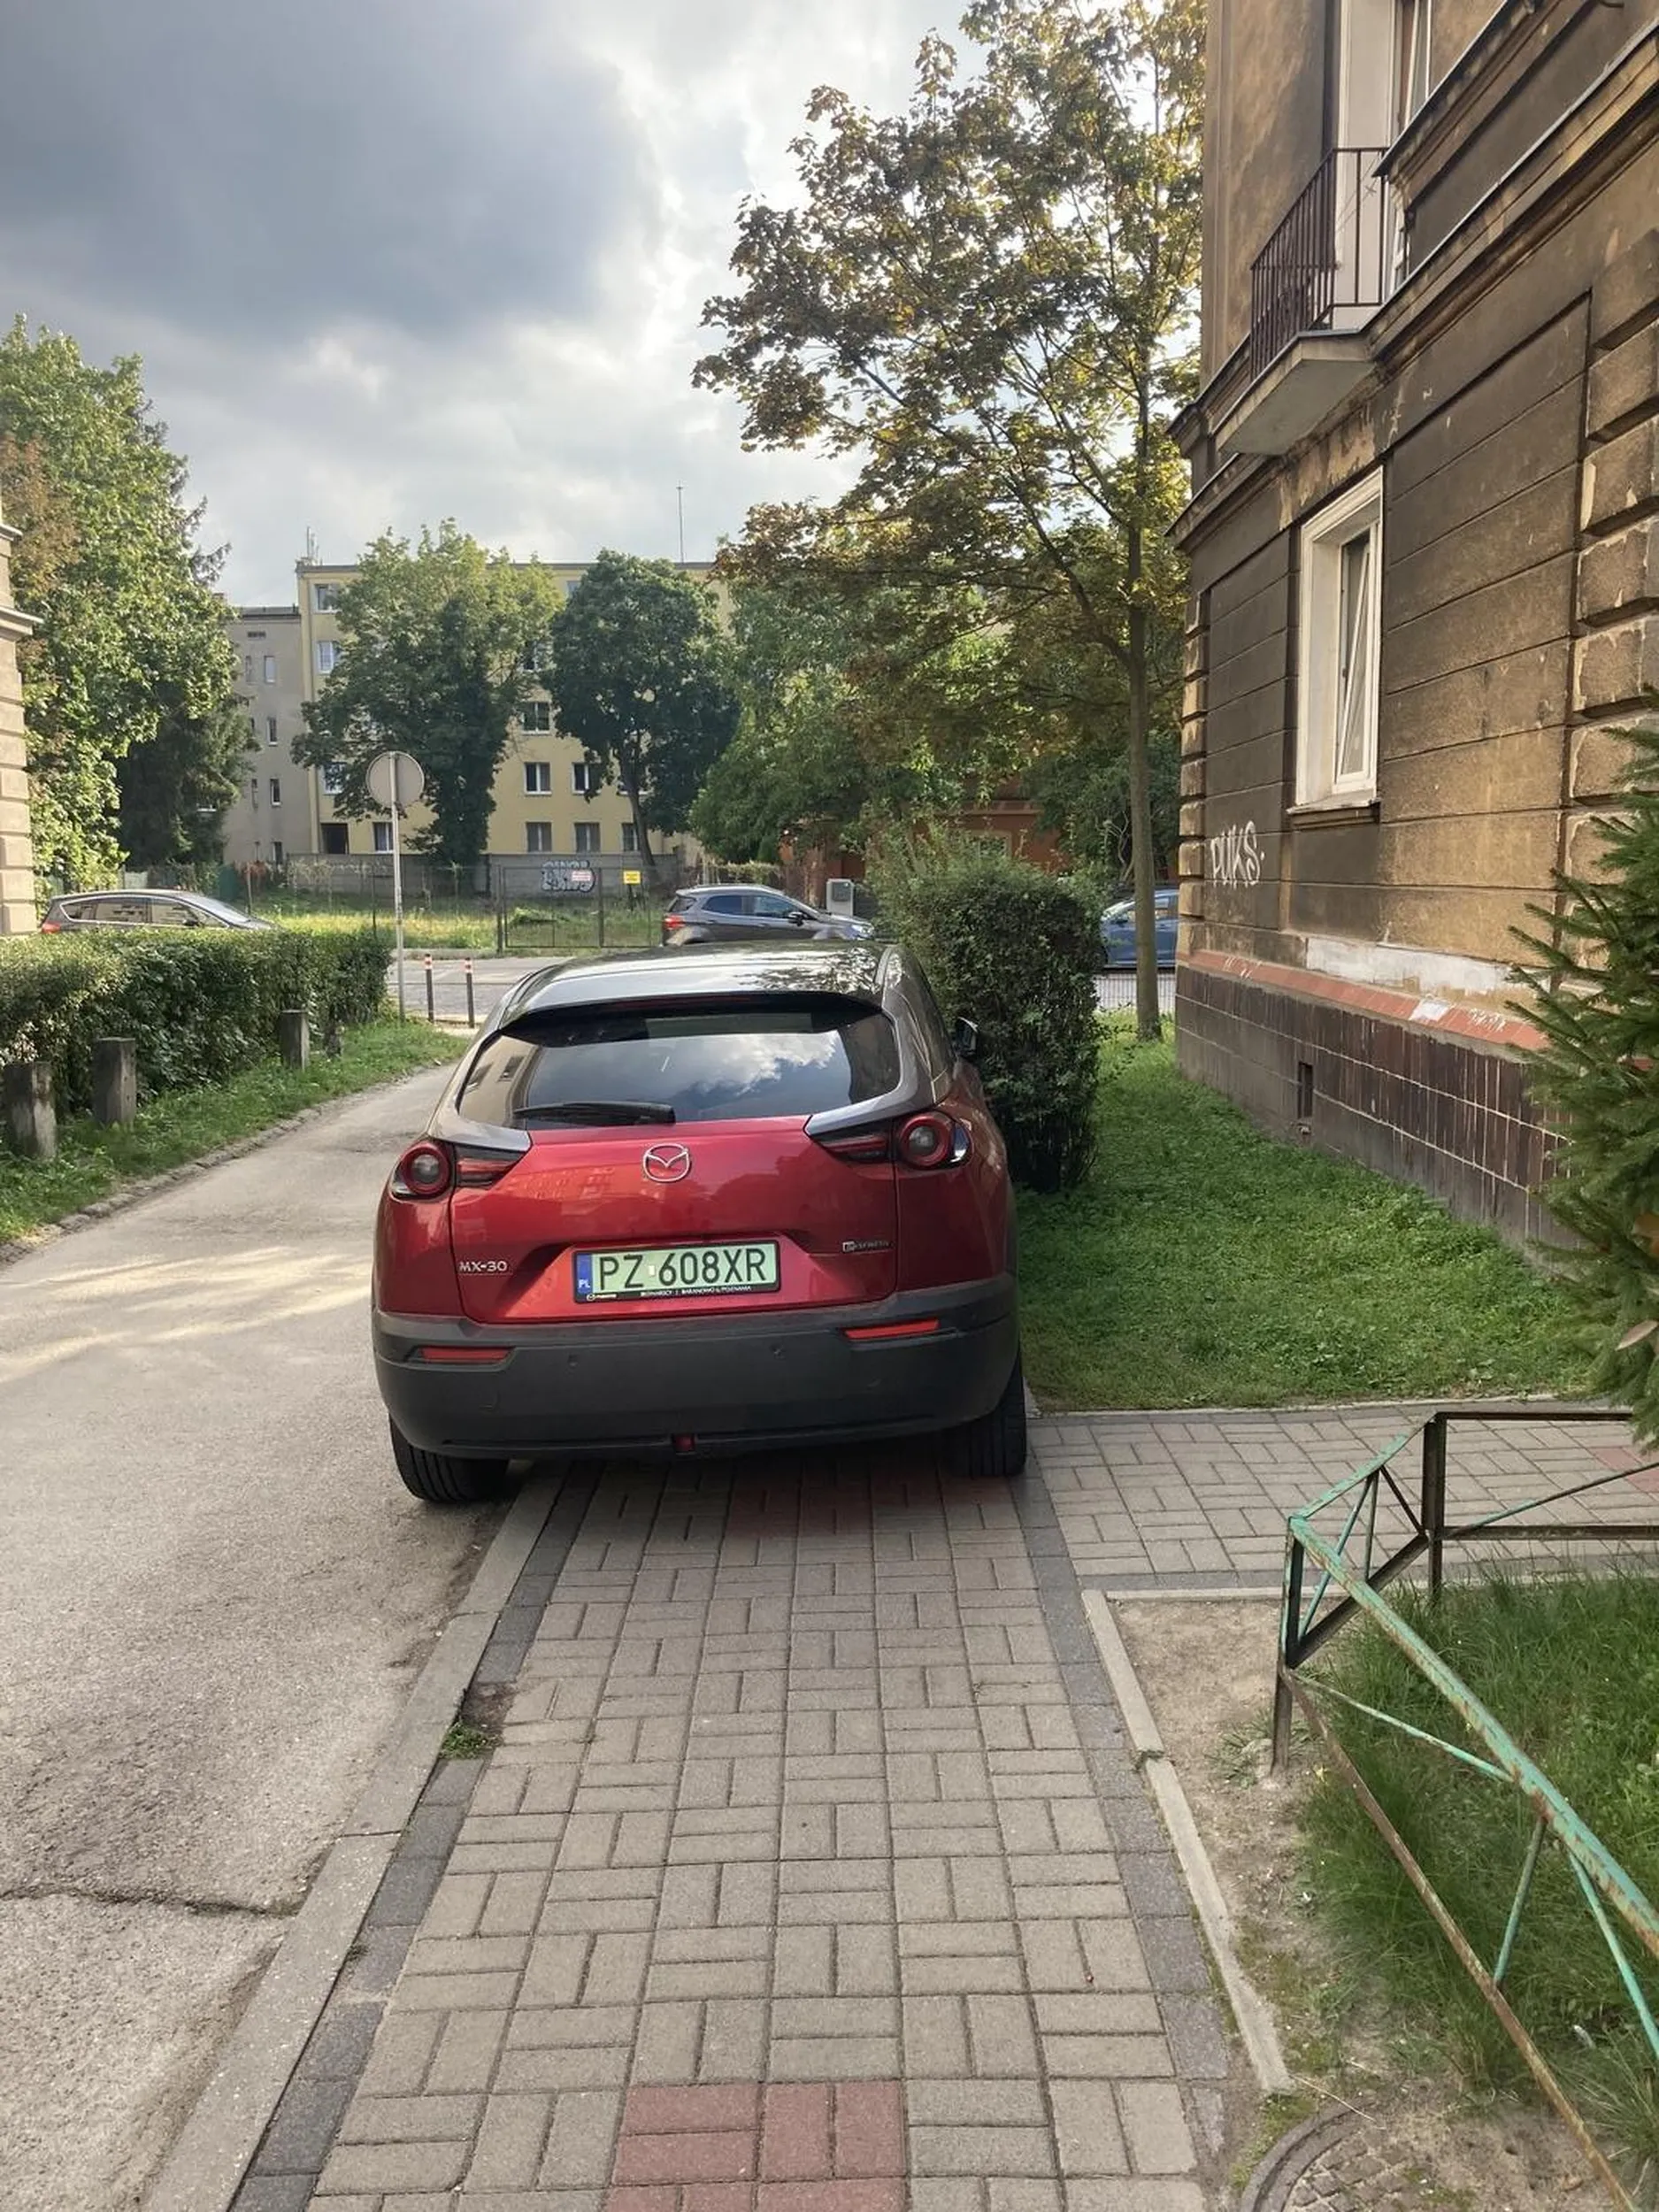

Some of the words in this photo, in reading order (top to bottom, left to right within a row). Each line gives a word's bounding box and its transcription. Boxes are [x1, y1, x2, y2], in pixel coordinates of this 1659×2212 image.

[460, 1261, 507, 1271] MX-30
[600, 1255, 644, 1290] PZ
[659, 1248, 765, 1286] 608XR
[579, 1279, 590, 1288] PL
